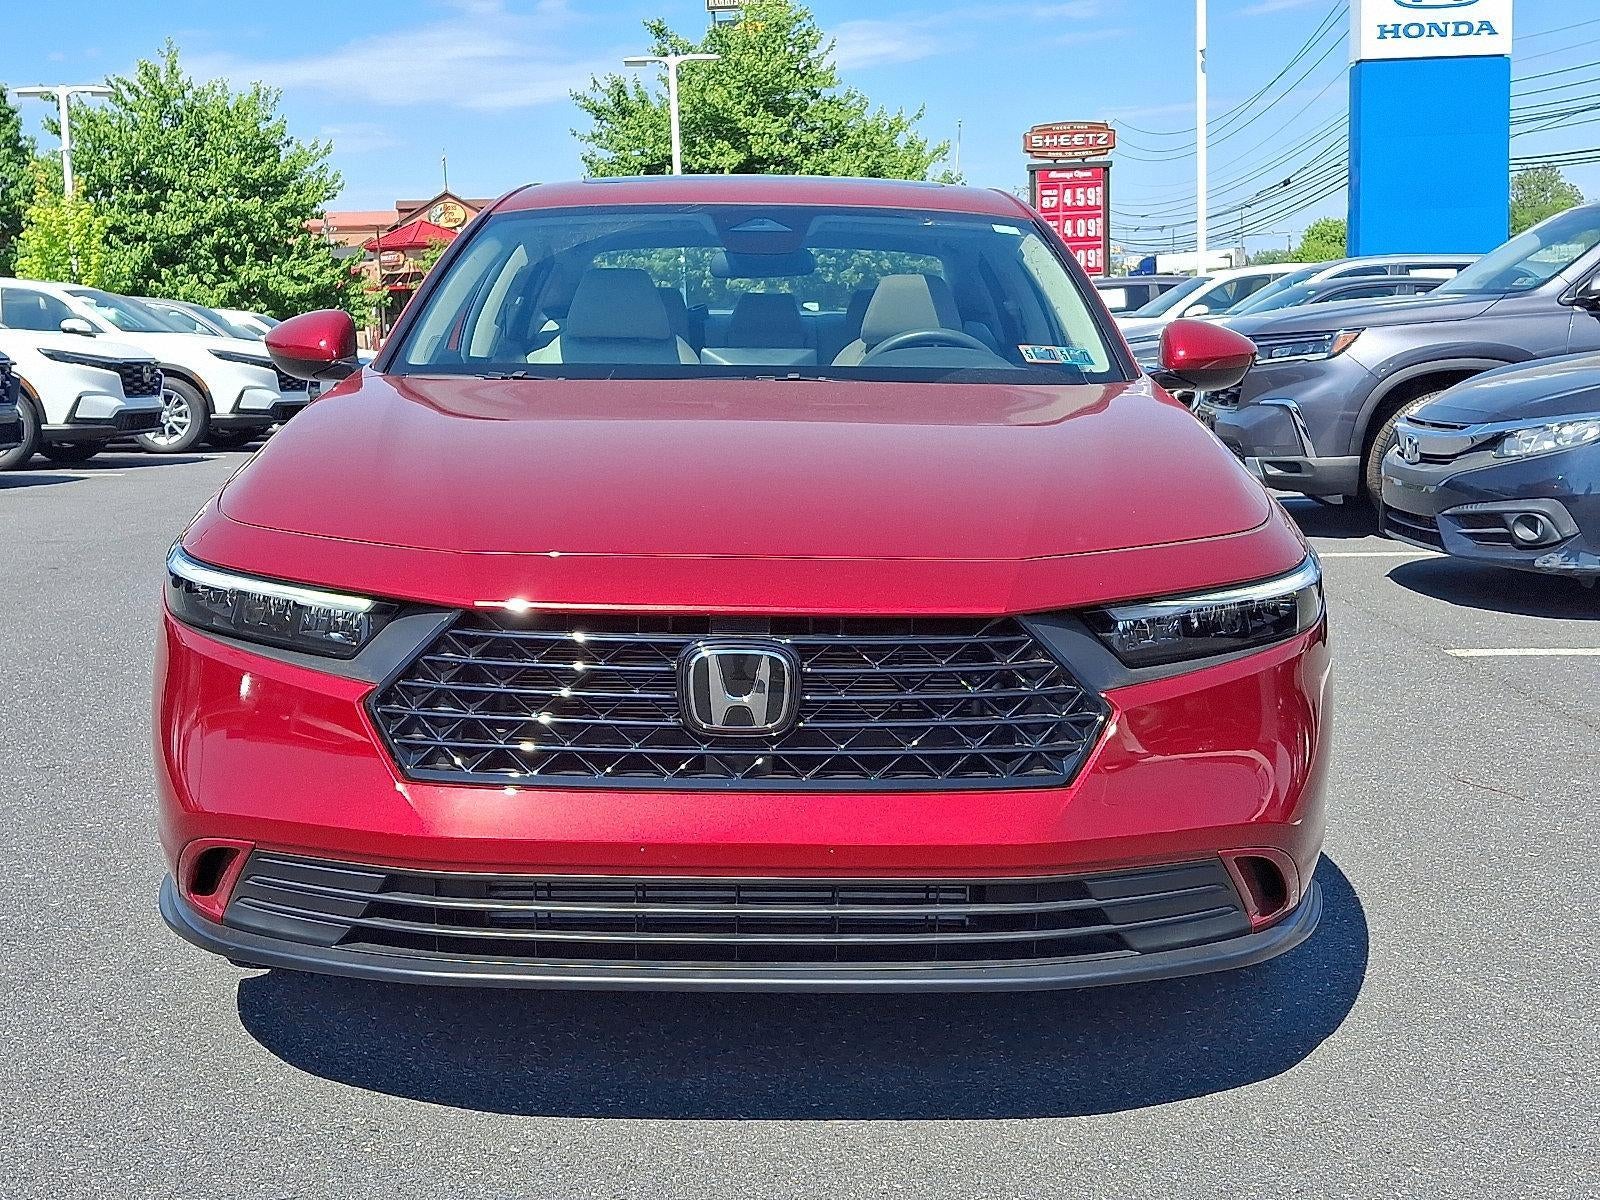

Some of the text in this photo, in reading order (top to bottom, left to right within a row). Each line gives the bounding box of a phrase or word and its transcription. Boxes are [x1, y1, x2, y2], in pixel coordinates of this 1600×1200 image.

[1377, 20, 1499, 39] HONDA
[1031, 133, 1108, 147] SHEETZ
[1041, 197, 1058, 208] 87
